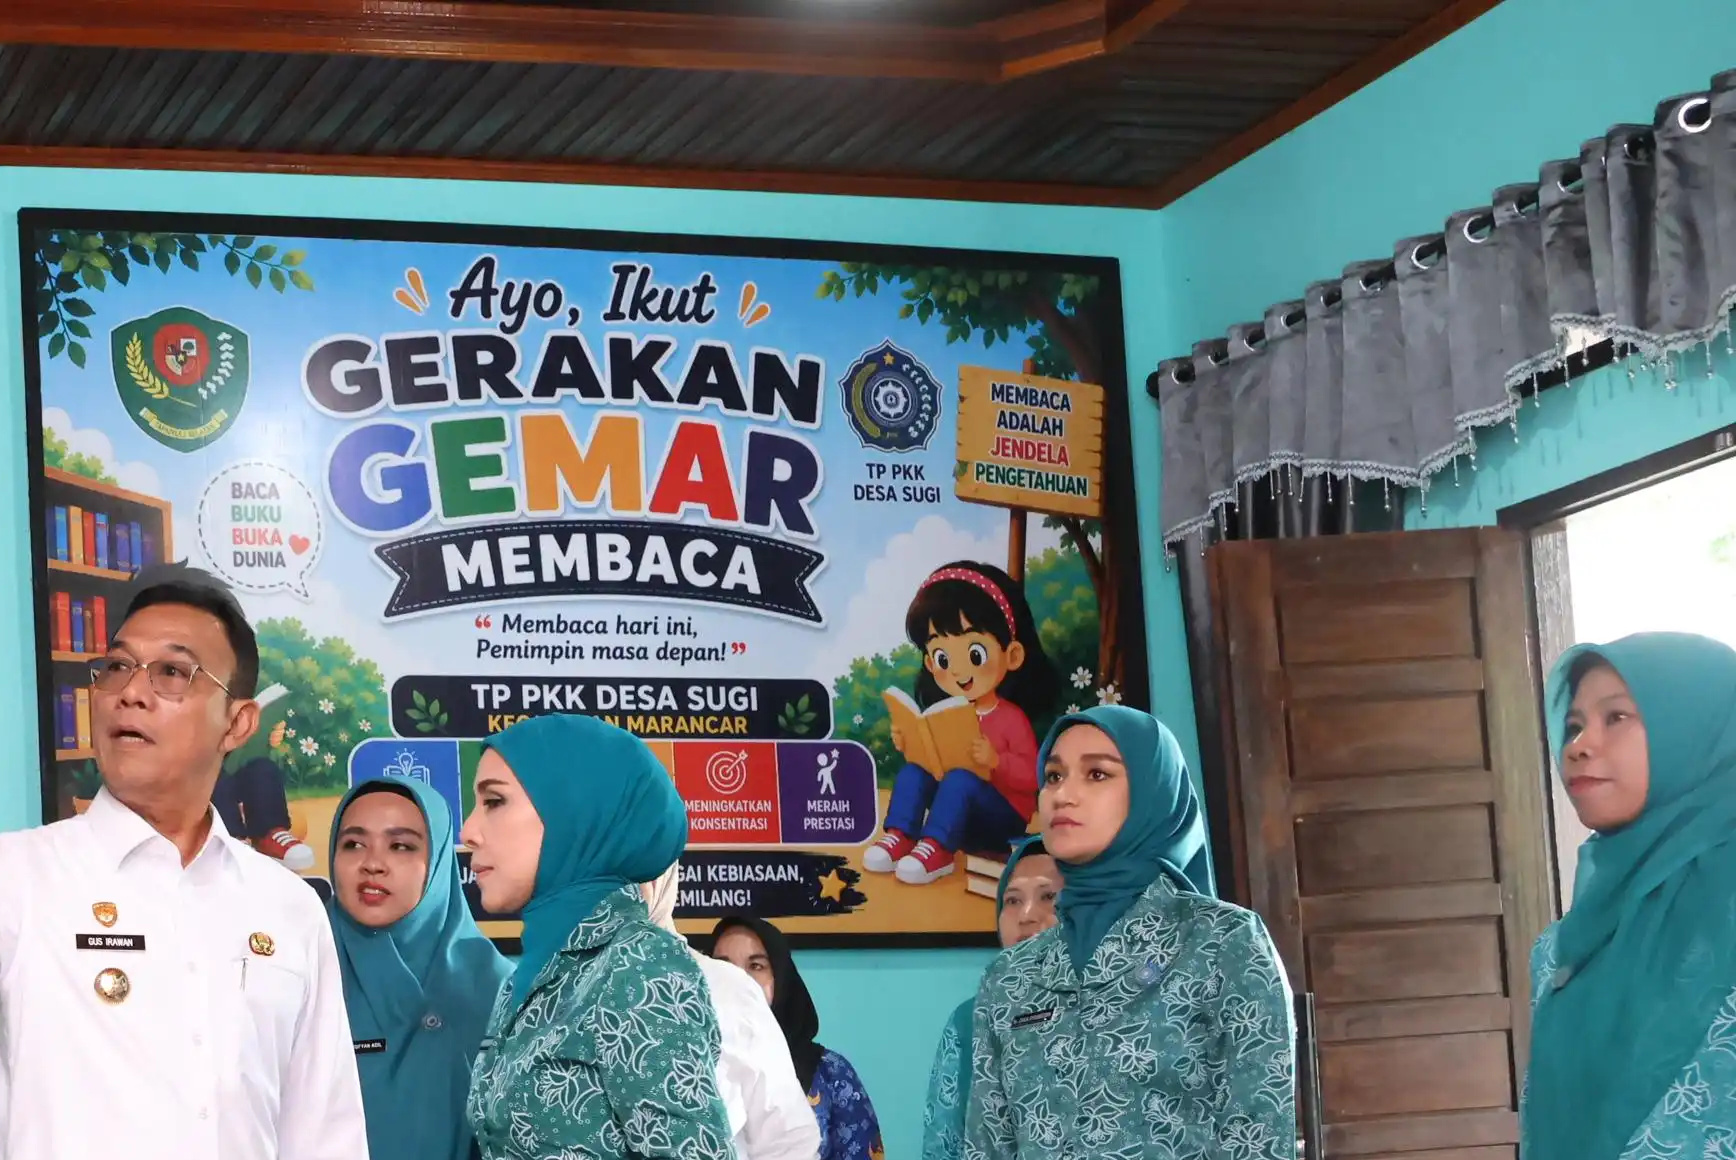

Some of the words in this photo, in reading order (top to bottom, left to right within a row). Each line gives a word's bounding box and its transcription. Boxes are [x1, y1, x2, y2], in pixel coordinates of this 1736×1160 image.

[448, 254, 581, 336] Ayo,
[602, 264, 717, 325] Ikut
[305, 334, 821, 424] GERAKAN
[990, 384, 1072, 413] MEMBACA
[996, 409, 1065, 438] ADALAH
[989, 436, 1070, 467] JENDELA
[327, 414, 820, 536] GEMAR
[866, 463, 887, 481] TP
[892, 463, 925, 482] PKK
[974, 462, 1089, 497] PENGETAHUAN
[230, 481, 280, 501] BACA
[853, 484, 897, 503] DESA
[902, 485, 942, 504] SUGI
[230, 505, 283, 525] BUKU
[231, 527, 284, 547] BUKA
[232, 550, 287, 570] DUNIA
[440, 533, 762, 596] MEMBACA
[615, 614, 660, 636] hari
[666, 616, 699, 639] ini,
[475, 639, 585, 664] Pemimpin
[591, 644, 648, 662] masa
[470, 683, 511, 710] TP
[521, 684, 587, 711] PKK
[596, 685, 679, 712] DESA
[686, 686, 759, 712] SUGI
[627, 714, 748, 734] MARANCAR
[685, 799, 772, 812] MENINGKATKAN
[806, 800, 851, 812] MERAIH
[690, 817, 768, 831] KONSENTRASI
[803, 817, 856, 830] PRESTASI
[707, 864, 805, 884] KEBIASAAN,
[87, 937, 104, 946] GUS
[105, 937, 134, 947] IRAWAN
